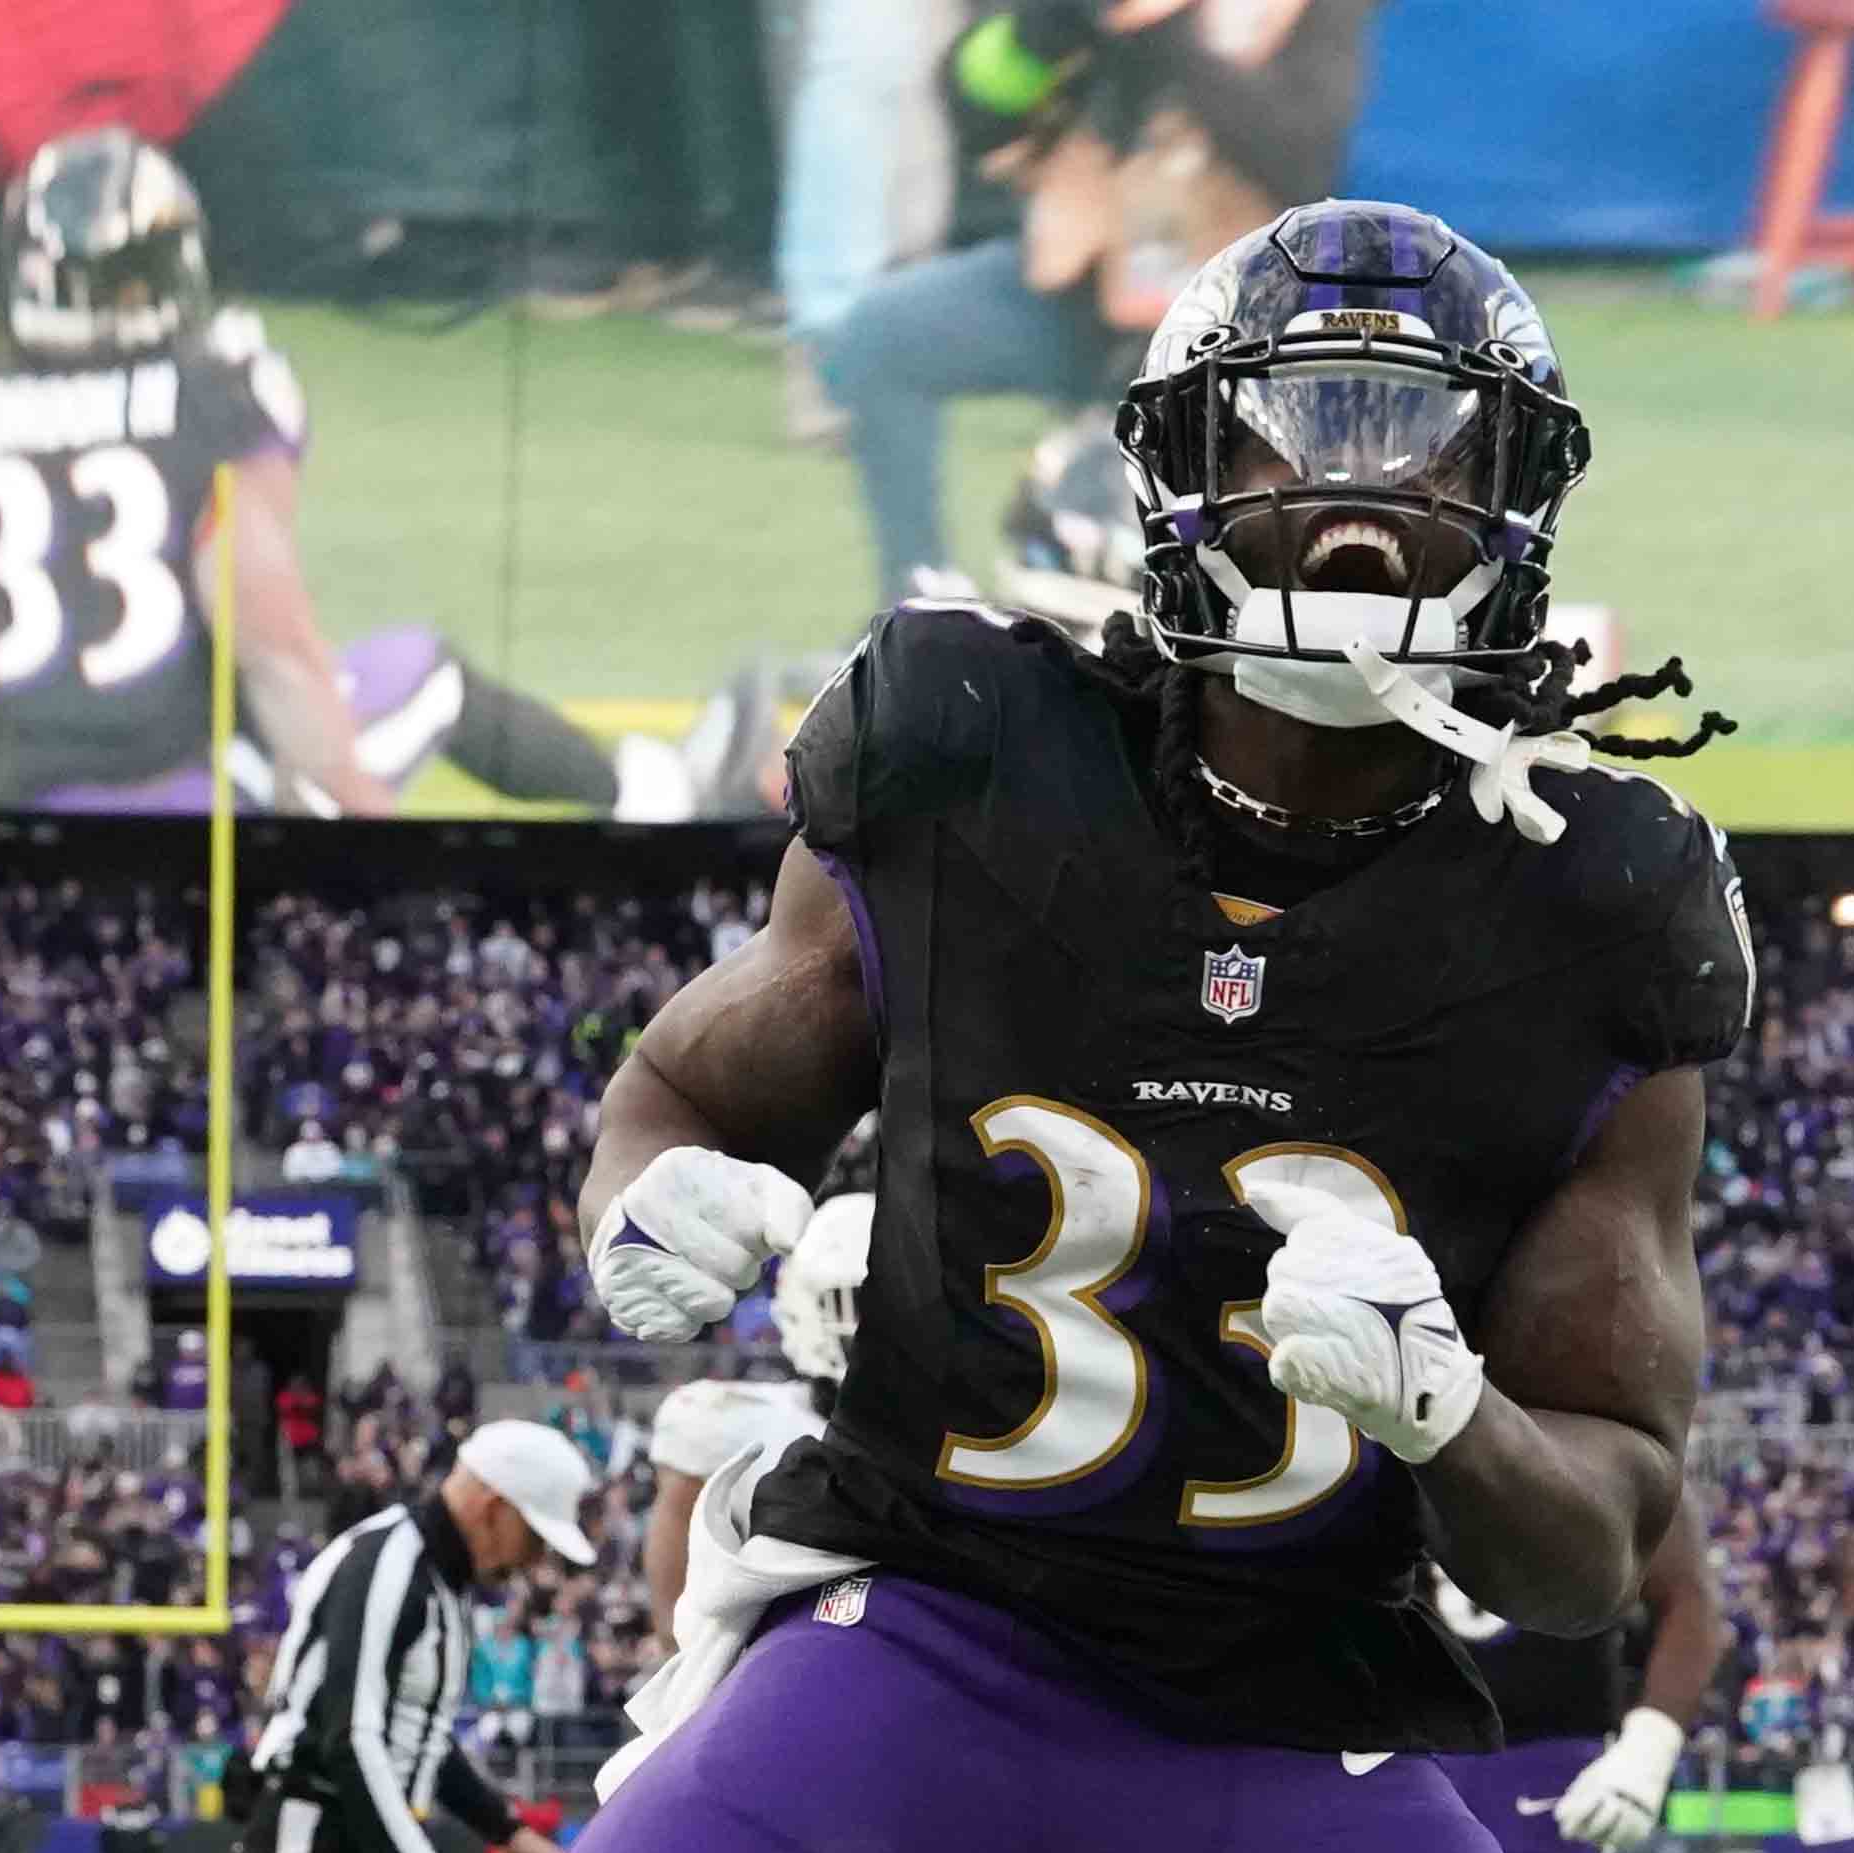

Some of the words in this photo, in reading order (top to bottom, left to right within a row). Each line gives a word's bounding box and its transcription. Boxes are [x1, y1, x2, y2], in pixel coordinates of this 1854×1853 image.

[1319, 312, 1401, 329] RAVENS
[1210, 979, 1253, 1009] NFL
[1132, 1081, 1293, 1112] RAVENS
